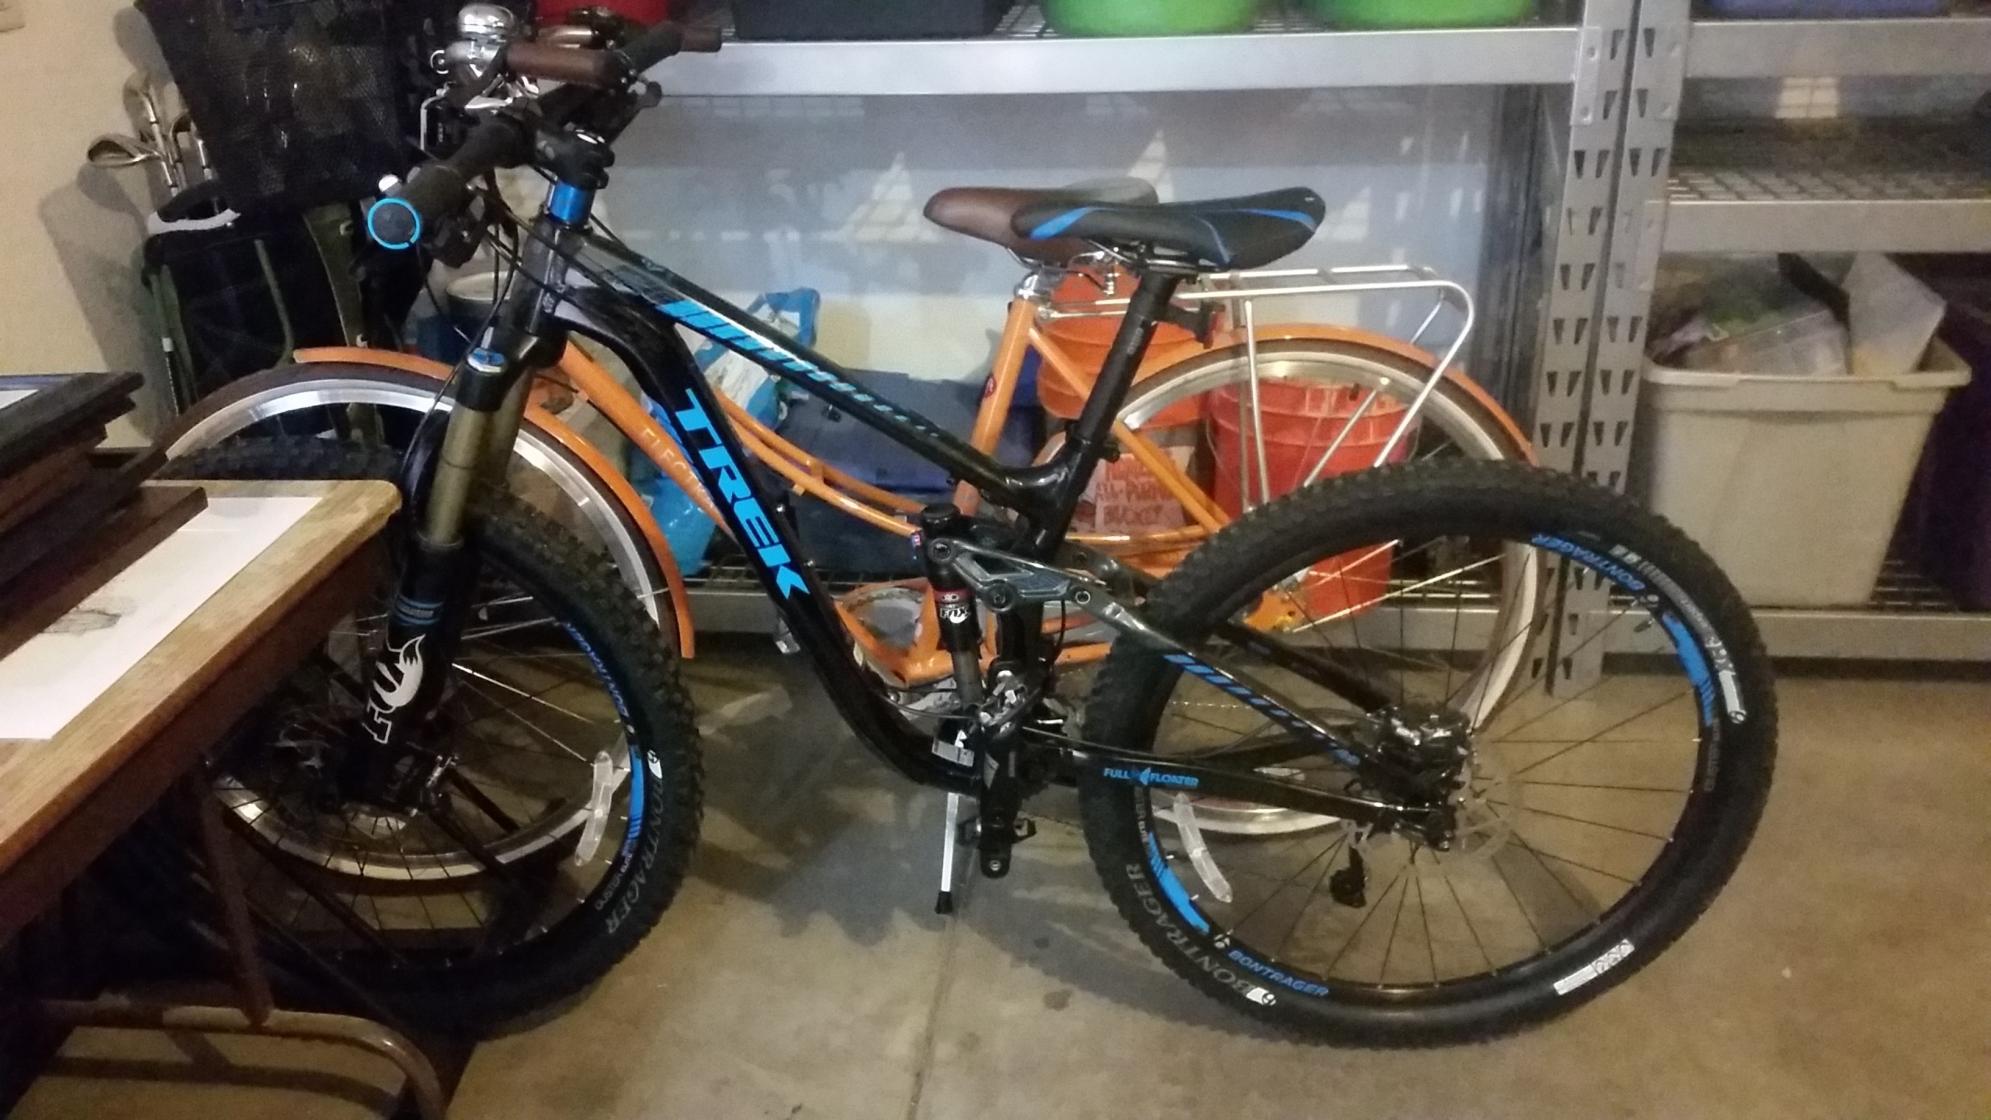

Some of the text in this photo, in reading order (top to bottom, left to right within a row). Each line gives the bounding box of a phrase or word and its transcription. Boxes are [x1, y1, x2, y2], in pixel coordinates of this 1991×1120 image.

[675, 388, 810, 599] TREK
[1531, 532, 1646, 592] BONTRAGER
[1103, 767, 1200, 788] FULL FLOATER
[1125, 863, 1257, 993] BONTRAGER
[1227, 948, 1331, 998] BONTRAGER
